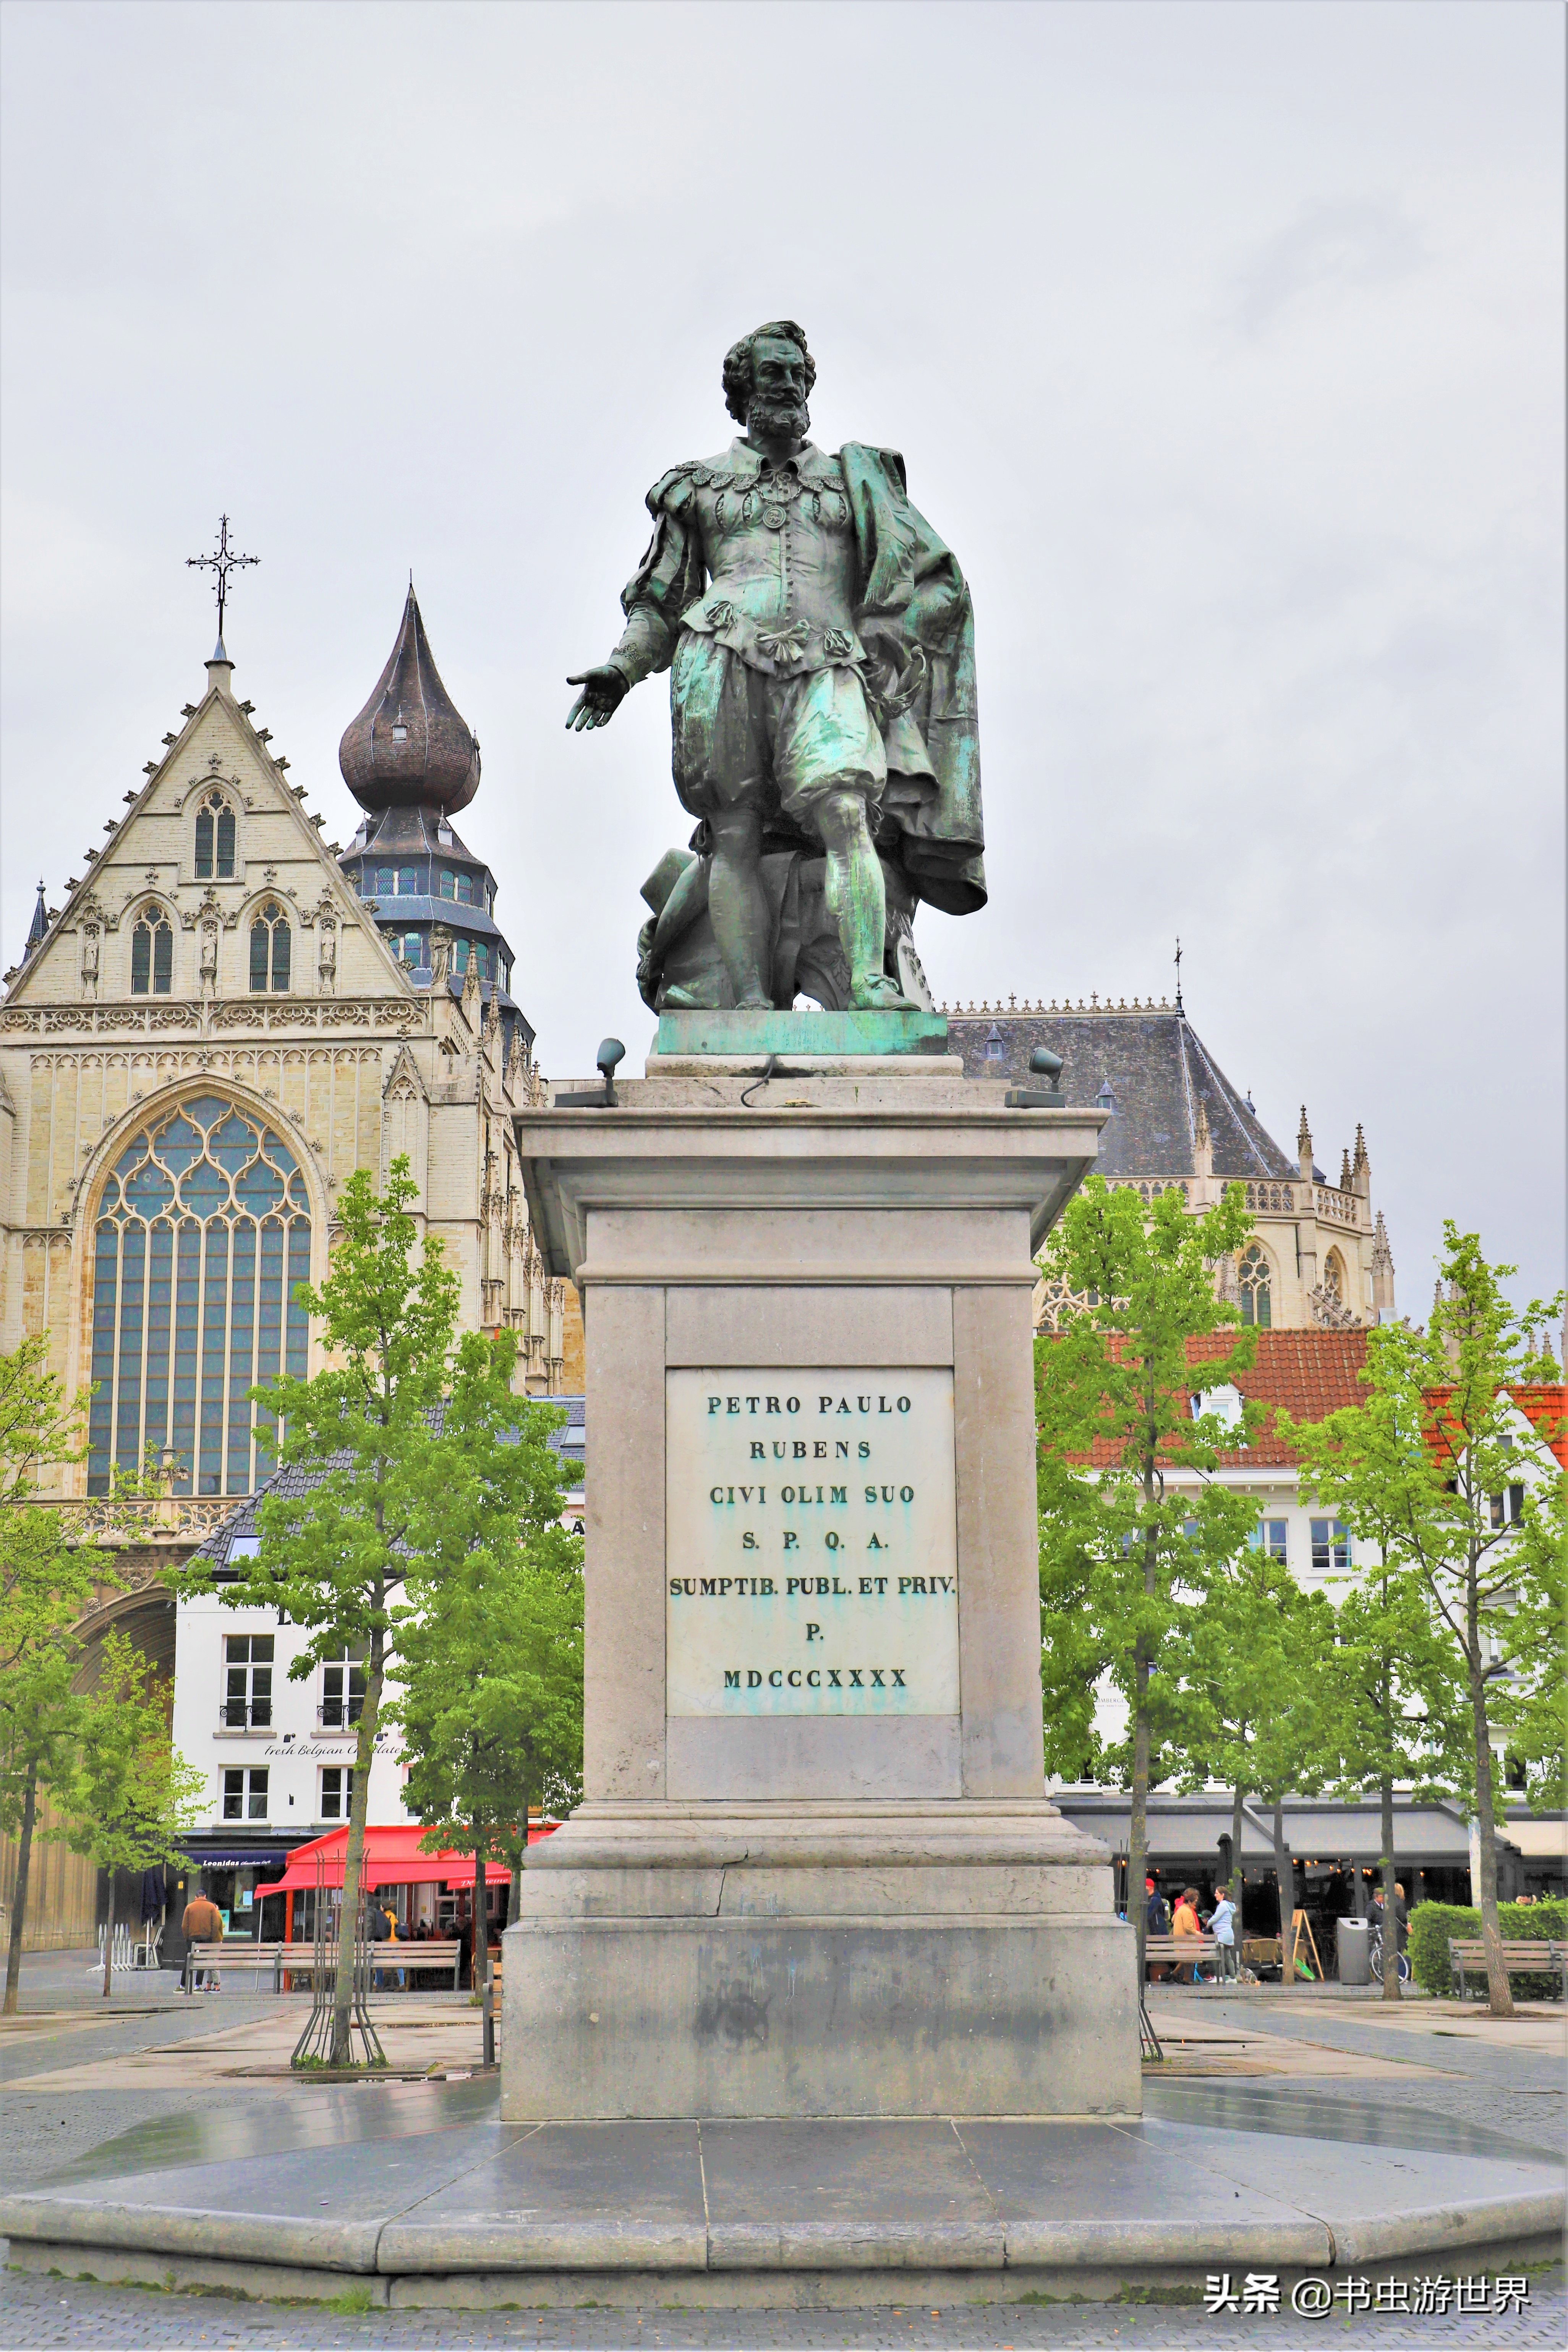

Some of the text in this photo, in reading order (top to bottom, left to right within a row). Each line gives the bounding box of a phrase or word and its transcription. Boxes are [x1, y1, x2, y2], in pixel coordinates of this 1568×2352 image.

[708, 1396, 911, 1414] PETRO PAULO
[750, 1442, 870, 1459] RUBENS
[710, 1486, 914, 1504] CIVI OLIM SUO
[743, 1532, 888, 1551] S. P. Q. A.
[670, 1577, 956, 1596] SUMPTIB. PUBL. ET PRIV.
[806, 1624, 824, 1641] P.
[724, 1670, 906, 1688] MDCCCXXXX
[265, 1742, 407, 1758] Fresh Belgian Colates
